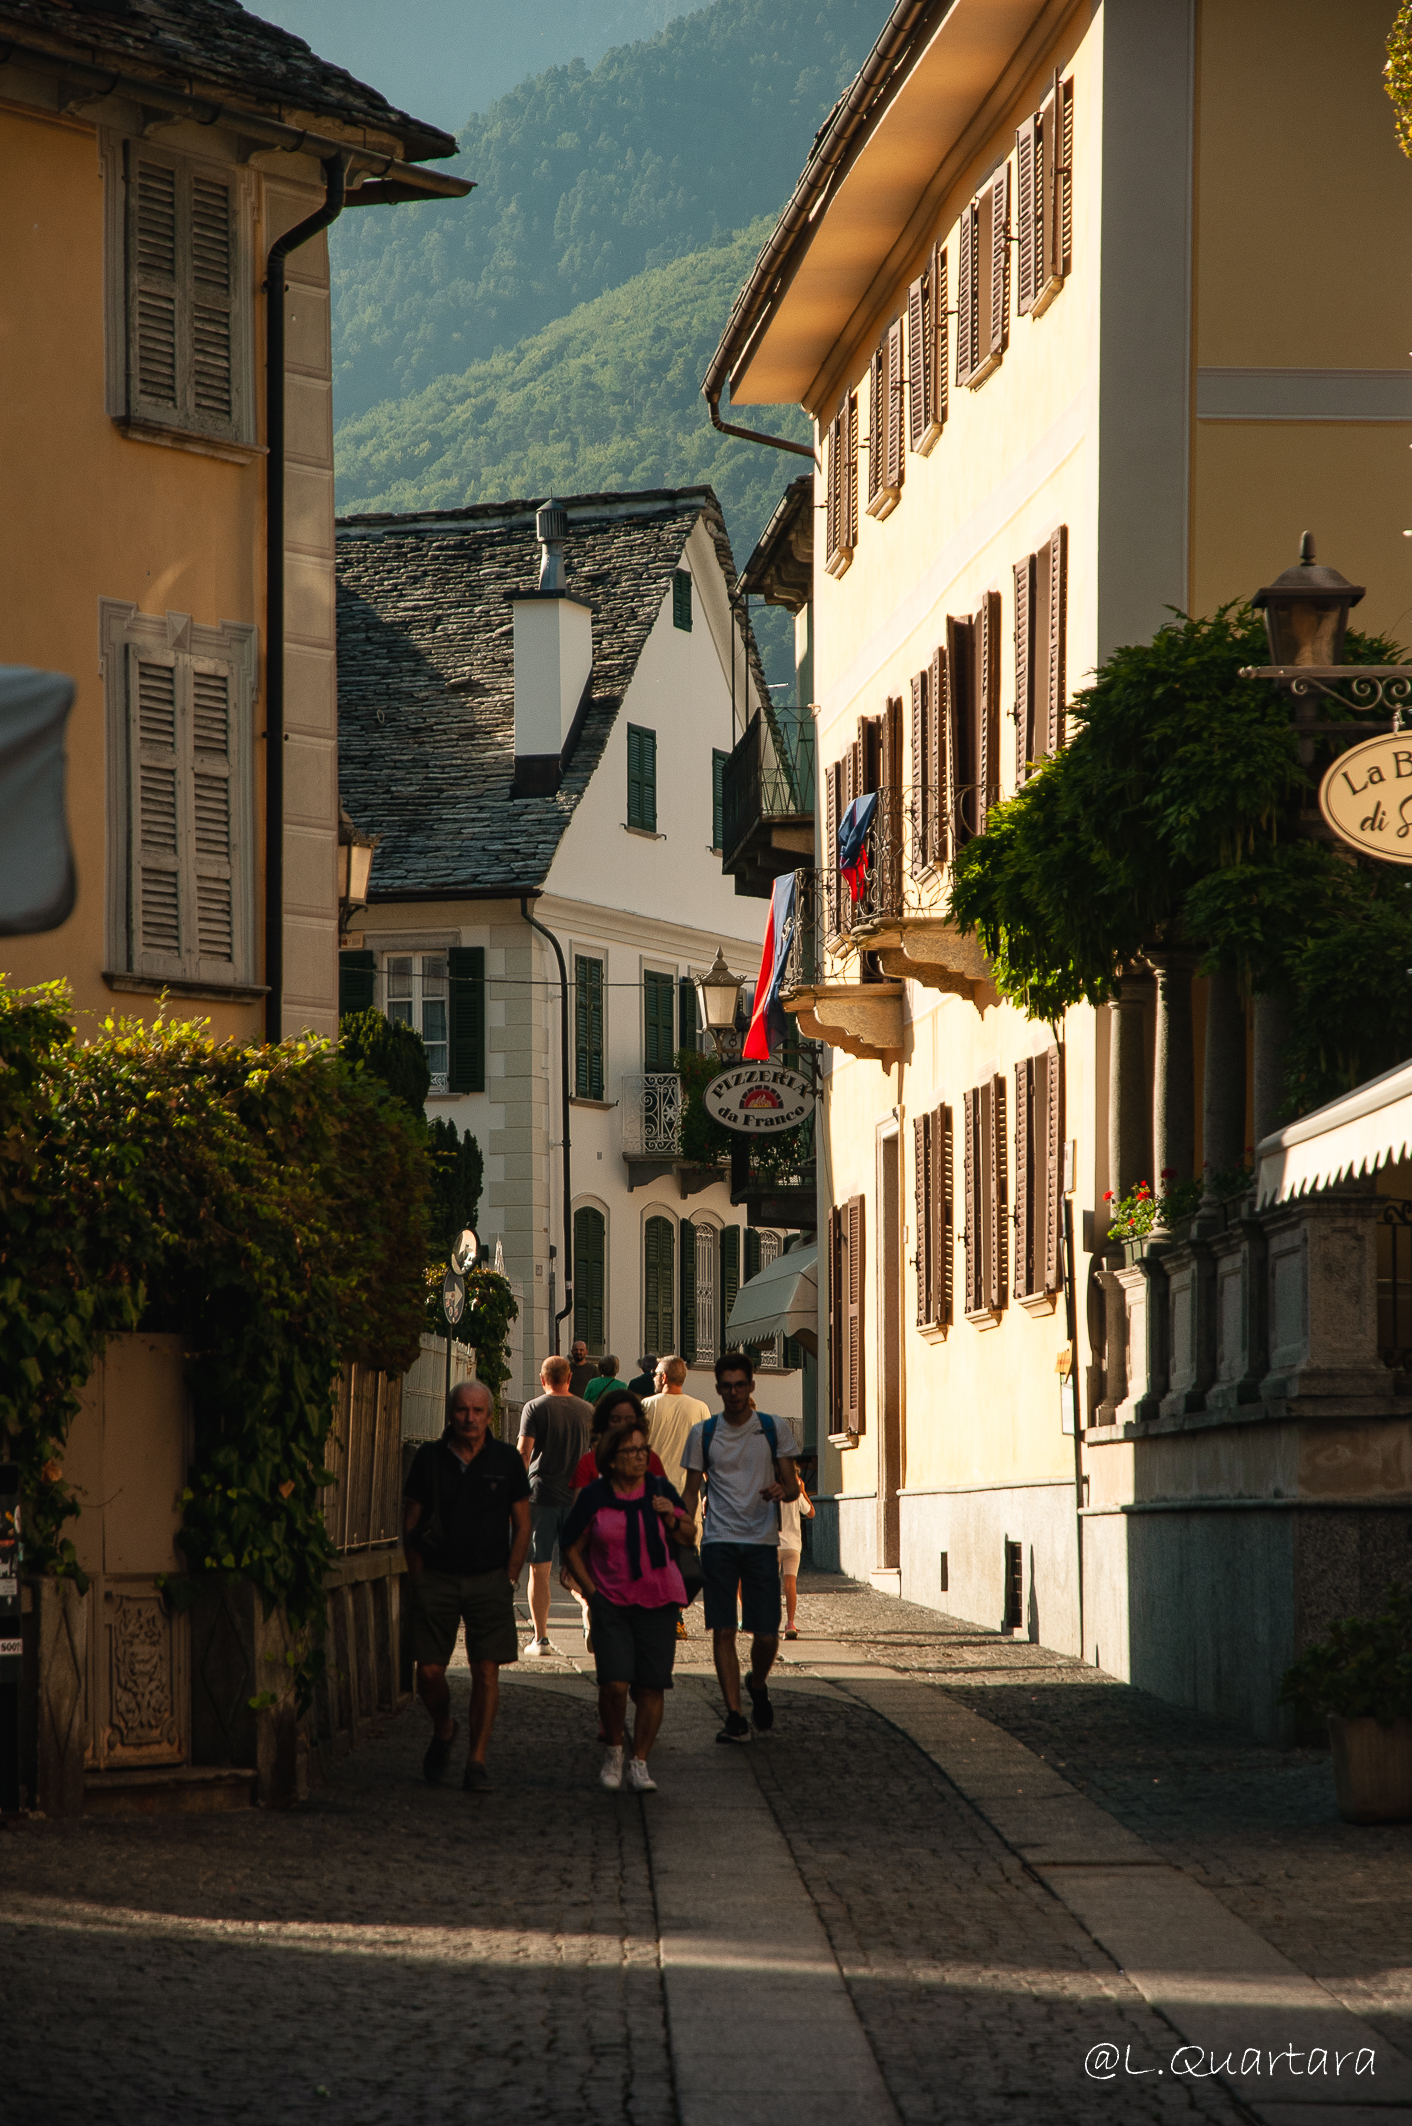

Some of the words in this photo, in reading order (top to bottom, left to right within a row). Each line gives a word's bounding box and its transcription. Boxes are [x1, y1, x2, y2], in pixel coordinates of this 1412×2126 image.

[1341, 766, 1387, 795] La
[1360, 800, 1390, 831] di
[711, 1070, 812, 1099] PIZZERIA
[718, 1107, 739, 1123] da
[742, 1105, 805, 1127] Franco
